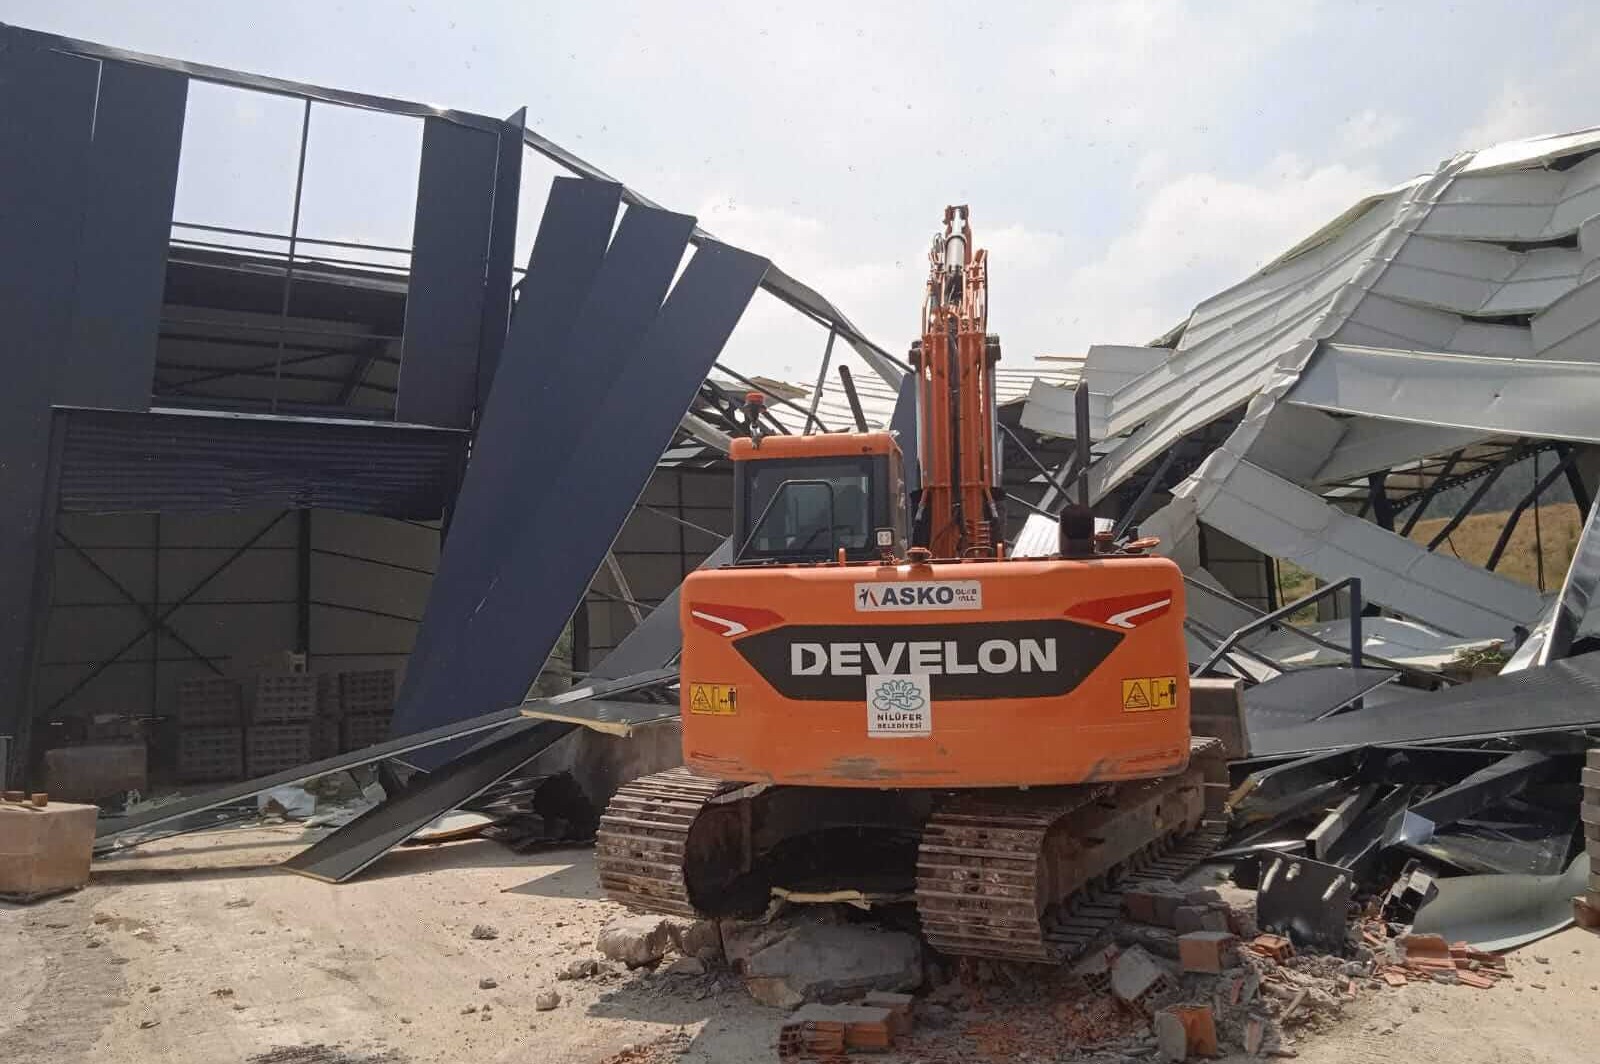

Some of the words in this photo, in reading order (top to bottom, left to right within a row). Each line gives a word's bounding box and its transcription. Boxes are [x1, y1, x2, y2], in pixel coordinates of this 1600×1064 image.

[881, 586, 954, 605] ASKO
[790, 638, 1057, 675] DEVELON
[877, 712, 922, 721] NİLÜFER
[877, 721, 922, 729] BELEDİYESİ
